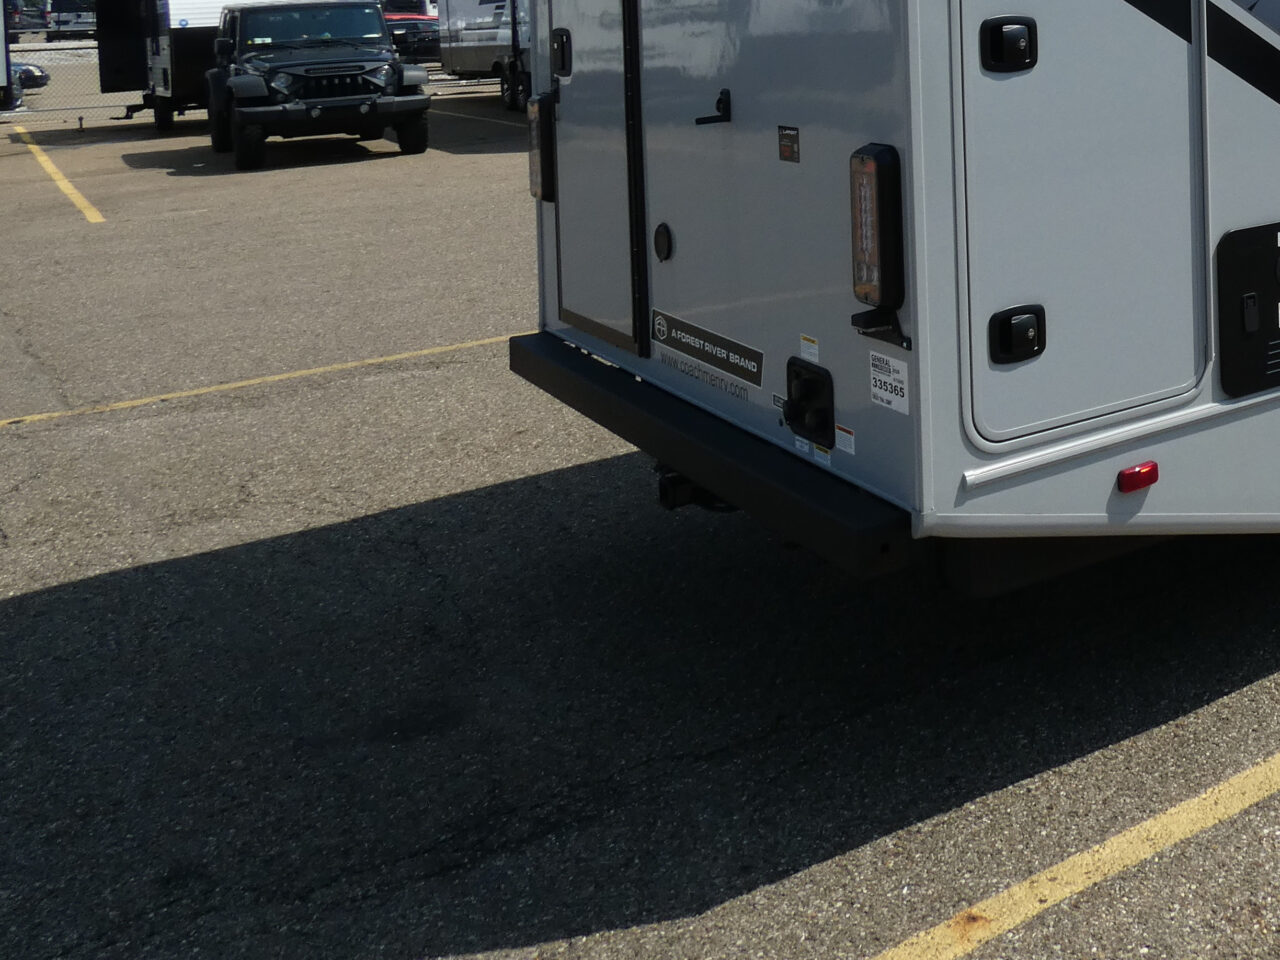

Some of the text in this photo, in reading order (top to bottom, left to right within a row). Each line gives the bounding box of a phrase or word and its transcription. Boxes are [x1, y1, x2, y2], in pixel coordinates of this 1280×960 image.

[671, 328, 758, 373] A FOREST RIVER BRAND
[872, 376, 905, 398] 335365
